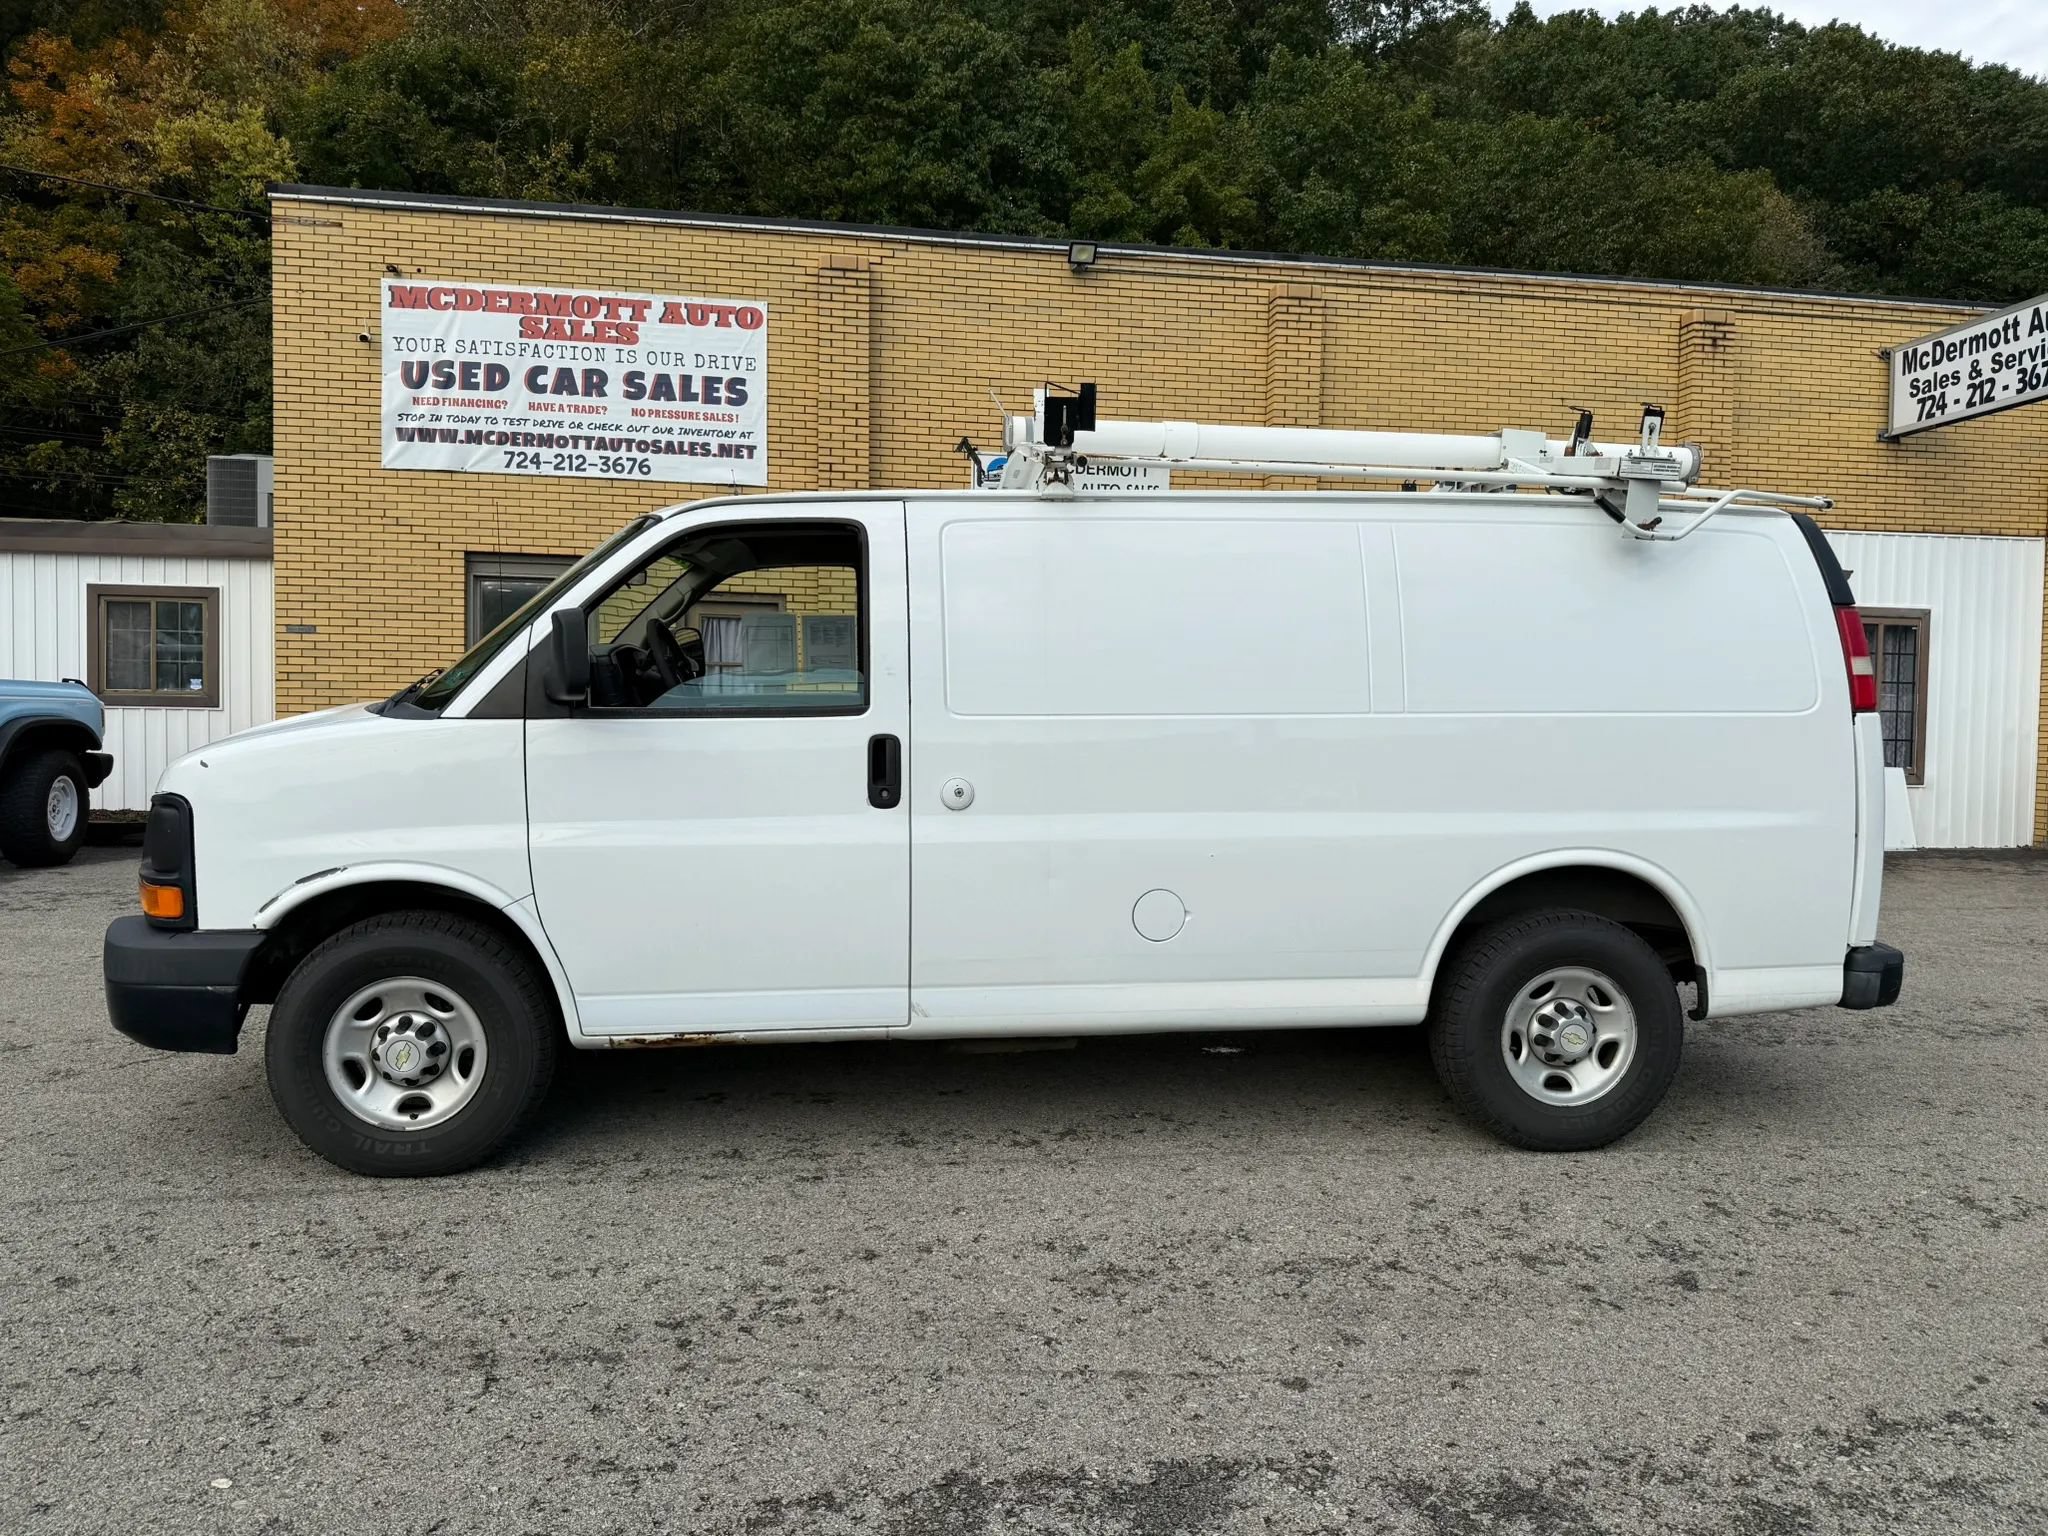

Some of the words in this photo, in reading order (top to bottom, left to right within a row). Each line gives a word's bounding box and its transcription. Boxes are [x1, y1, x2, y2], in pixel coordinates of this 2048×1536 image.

[388, 285, 652, 322] MCDERMOTT
[659, 302, 764, 330] AUTO
[519, 316, 639, 345] SALES
[1902, 315, 2020, 376] McDermott
[393, 336, 446, 354] YOUR
[455, 339, 606, 362] SATISFACTION
[615, 348, 637, 364] IS
[646, 351, 685, 367] OUR
[694, 353, 756, 371] DRIVE
[400, 360, 510, 391] USED
[524, 365, 608, 397] CAR
[622, 370, 748, 406] SALES
[1909, 370, 1961, 398] Sales
[1968, 359, 1983, 381] &
[412, 397, 443, 407] NEED
[442, 398, 508, 410] FINANCING?
[528, 402, 556, 412] HAVE
[558, 403, 566, 412] A
[567, 403, 608, 415] TRADE?
[631, 408, 646, 417] NO
[648, 409, 701, 421] PRESSURE
[1916, 391, 1947, 422] 724
[1966, 377, 1996, 409] 212
[397, 413, 425, 422] STOP
[428, 413, 442, 422] IN
[446, 414, 481, 424] TODAY
[484, 416, 498, 425] TO
[502, 417, 531, 427] TEST
[532, 419, 568, 429] DRIVE
[568, 421, 583, 430] OR
[587, 422, 623, 432] CHECK
[627, 424, 650, 433] OUT
[652, 426, 674, 435] OUR
[677, 427, 736, 438] INVENTORY
[739, 431, 754, 439] AT
[395, 427, 757, 459] WWW.MCDERMOTTAUTOSALES.NET
[504, 451, 651, 475] 724-212-3676
